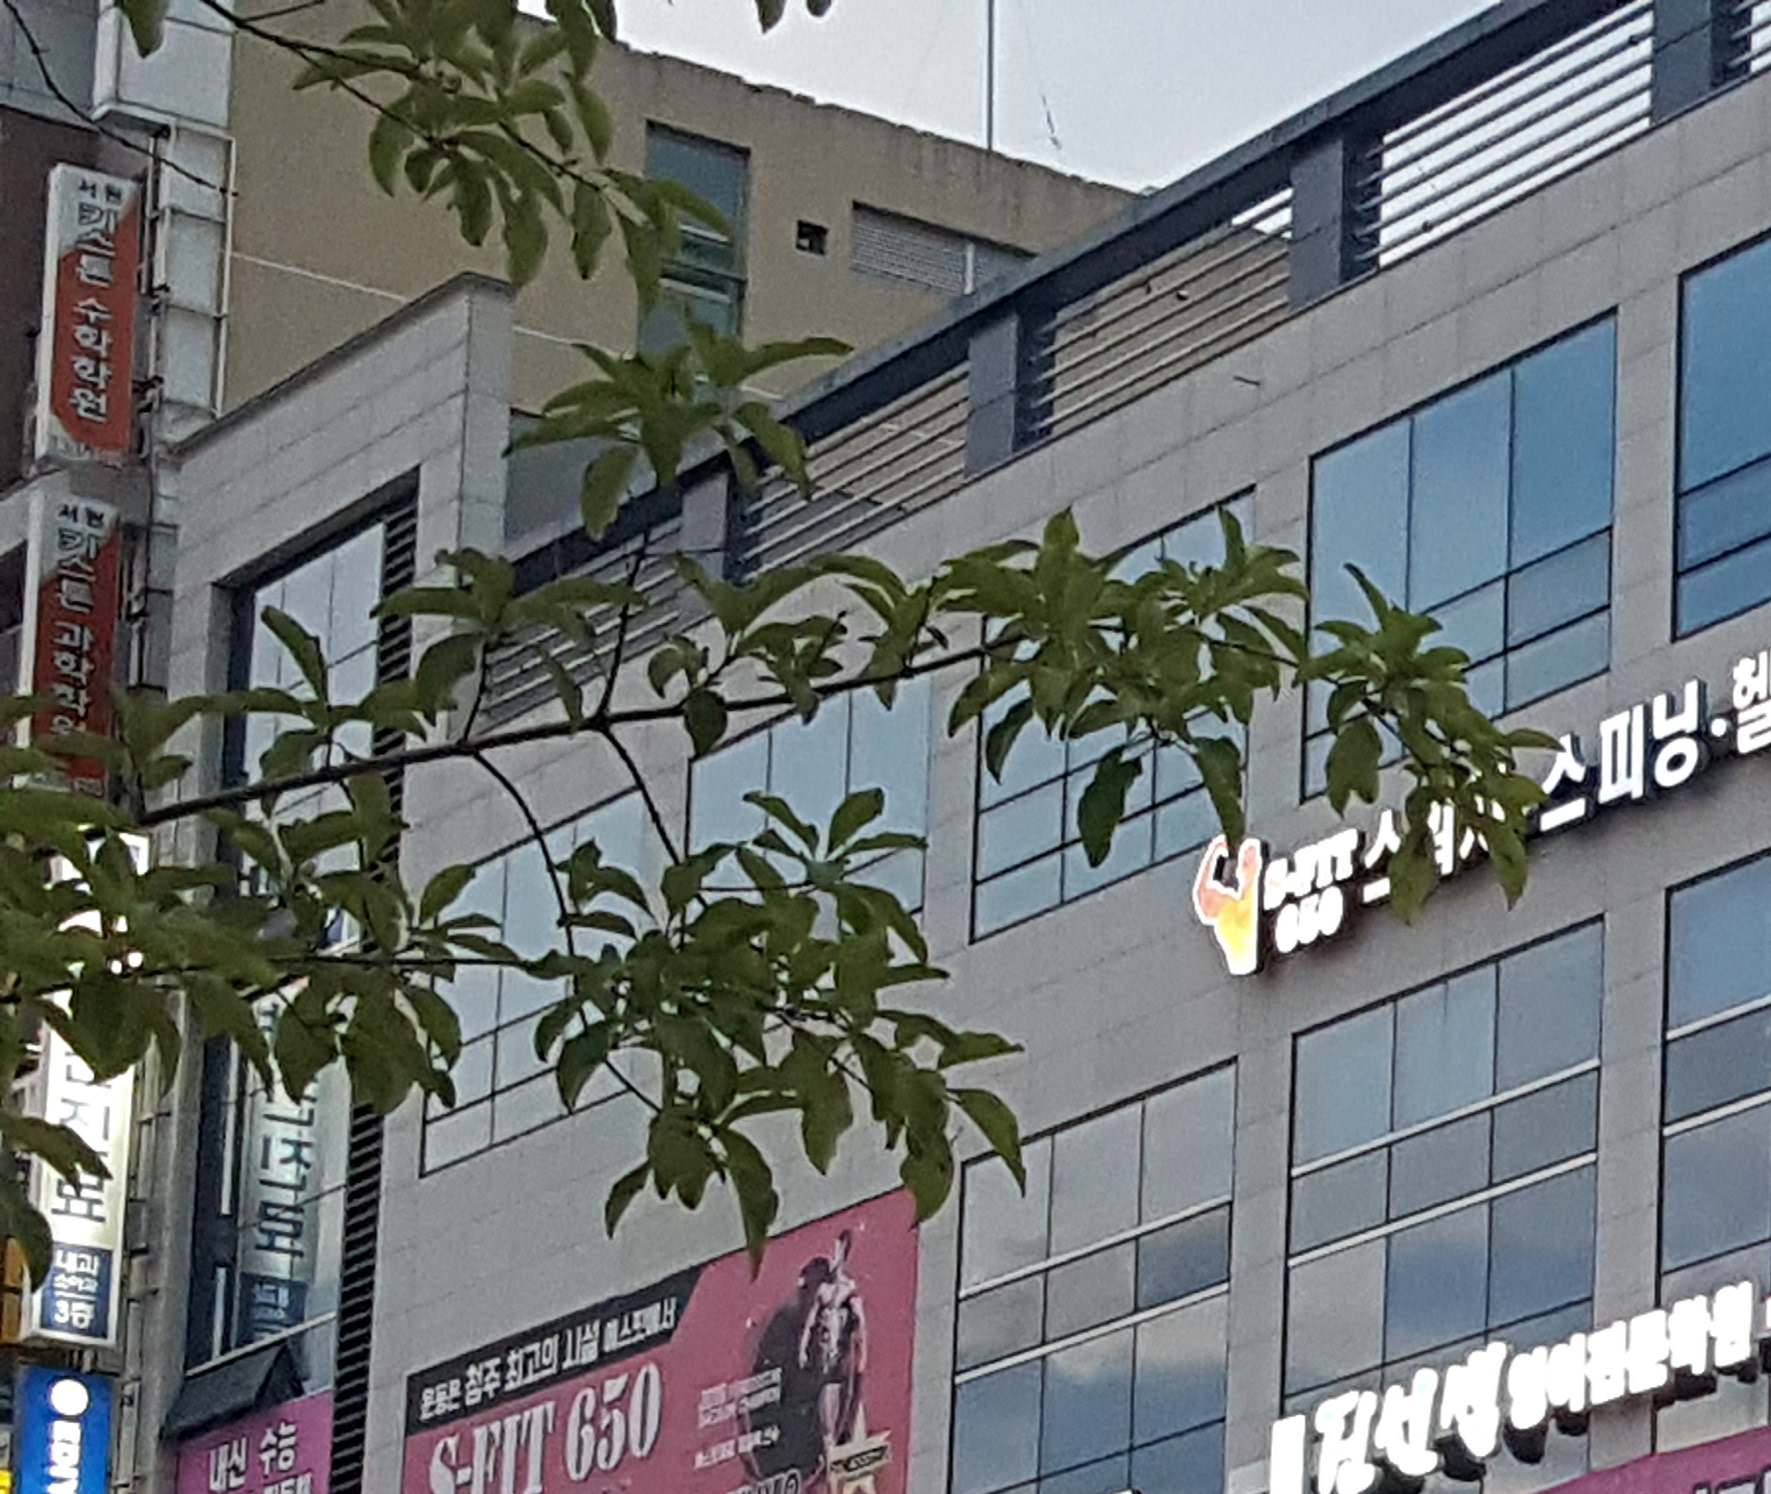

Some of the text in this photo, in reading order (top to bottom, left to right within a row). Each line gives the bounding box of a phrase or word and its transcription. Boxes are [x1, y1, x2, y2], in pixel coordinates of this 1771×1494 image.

[54, 1299, 96, 1331] 3층
[504, 1333, 560, 1392] 최고의
[565, 1362, 662, 1481] 650
[208, 1421, 300, 1494] 내신 수능
